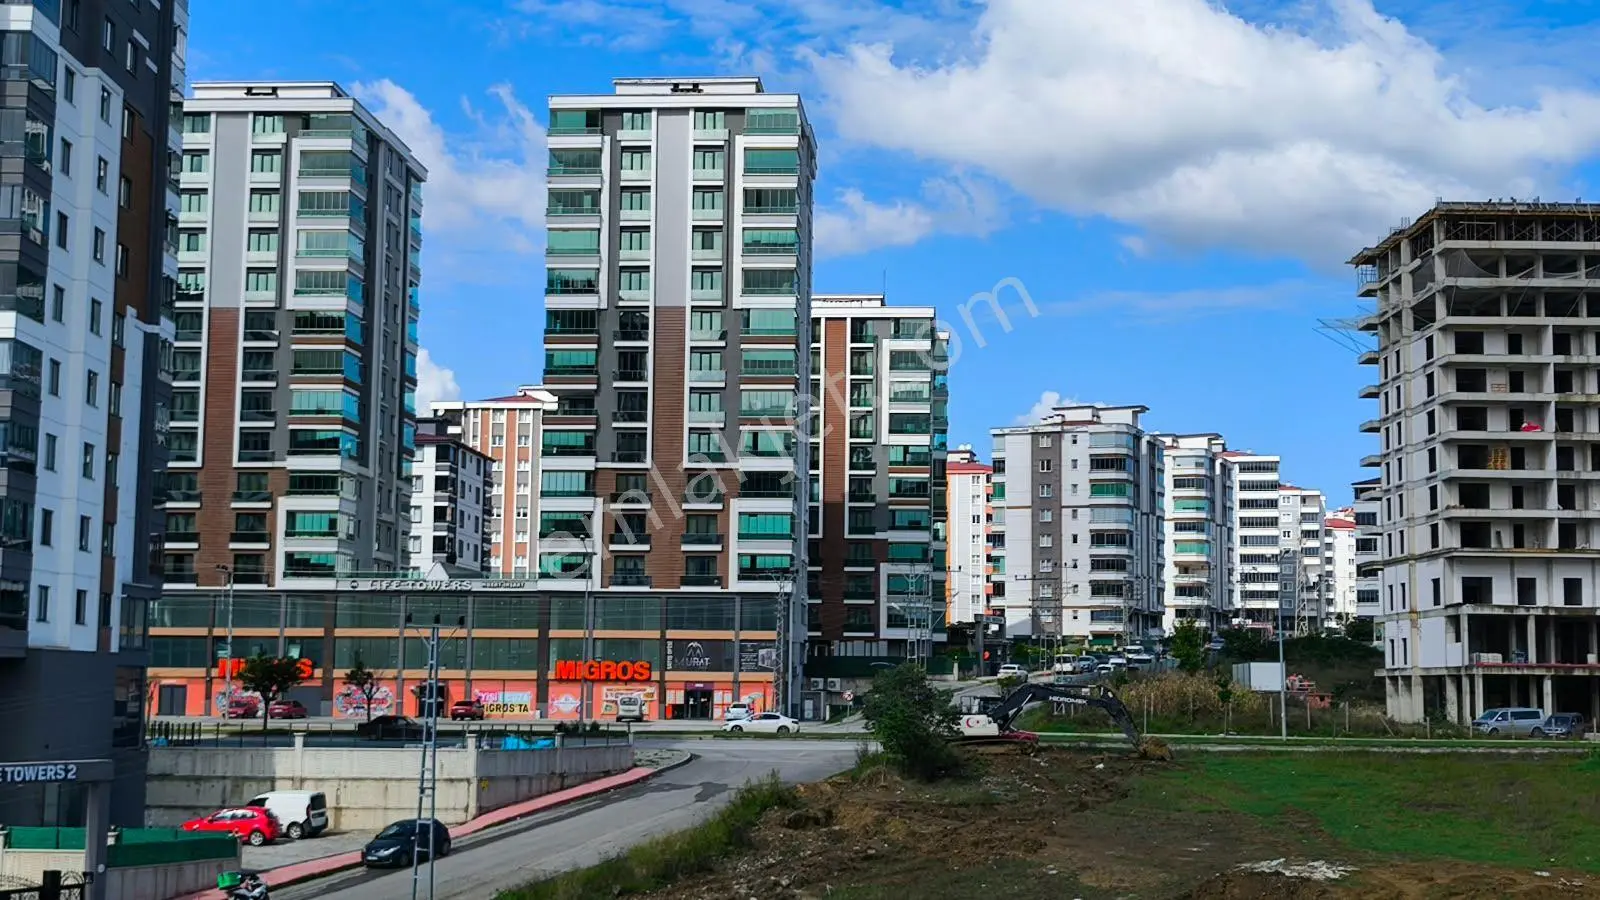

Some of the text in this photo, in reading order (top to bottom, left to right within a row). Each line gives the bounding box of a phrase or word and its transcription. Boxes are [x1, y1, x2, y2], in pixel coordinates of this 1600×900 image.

[369, 580, 472, 591] LIFE TOWERS
[4, 764, 66, 782] TOWERS
[67, 764, 77, 780] 2
